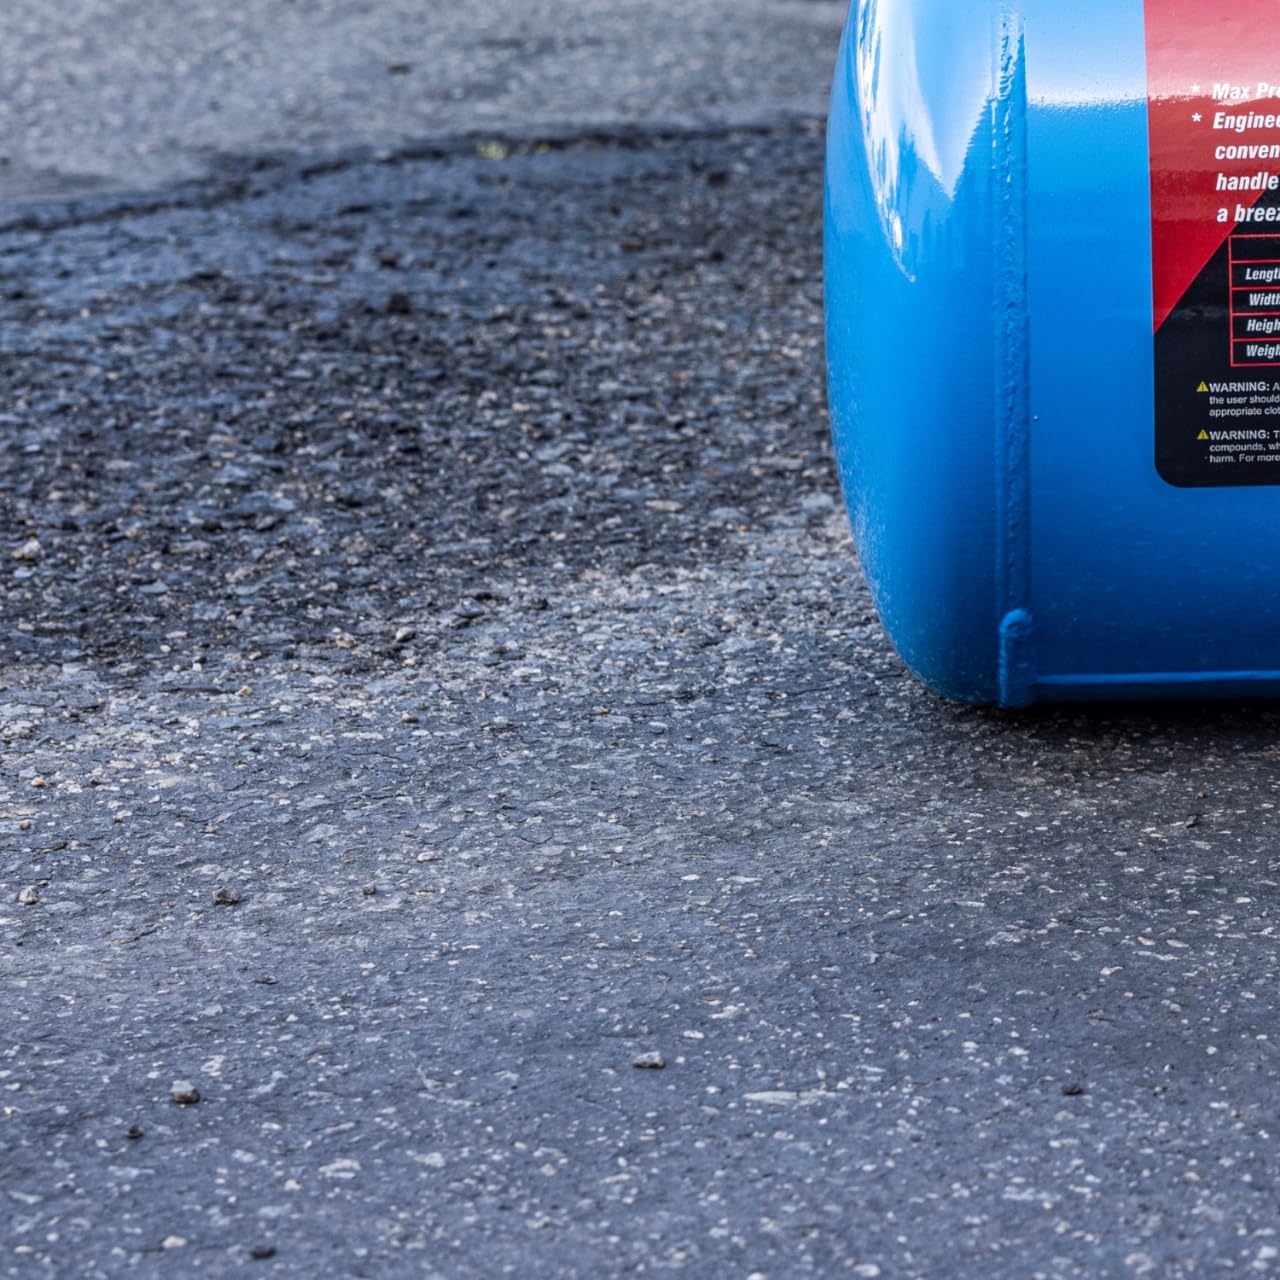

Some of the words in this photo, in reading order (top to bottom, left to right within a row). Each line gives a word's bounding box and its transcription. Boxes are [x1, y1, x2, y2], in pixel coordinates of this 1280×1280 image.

[1212, 84, 1248, 100] Max
[1216, 171, 1278, 190] handle
[1216, 207, 1228, 222] a
[1209, 381, 1270, 392] WARNING:
[1209, 453, 1235, 462] harm.
[1238, 453, 1255, 462] For
